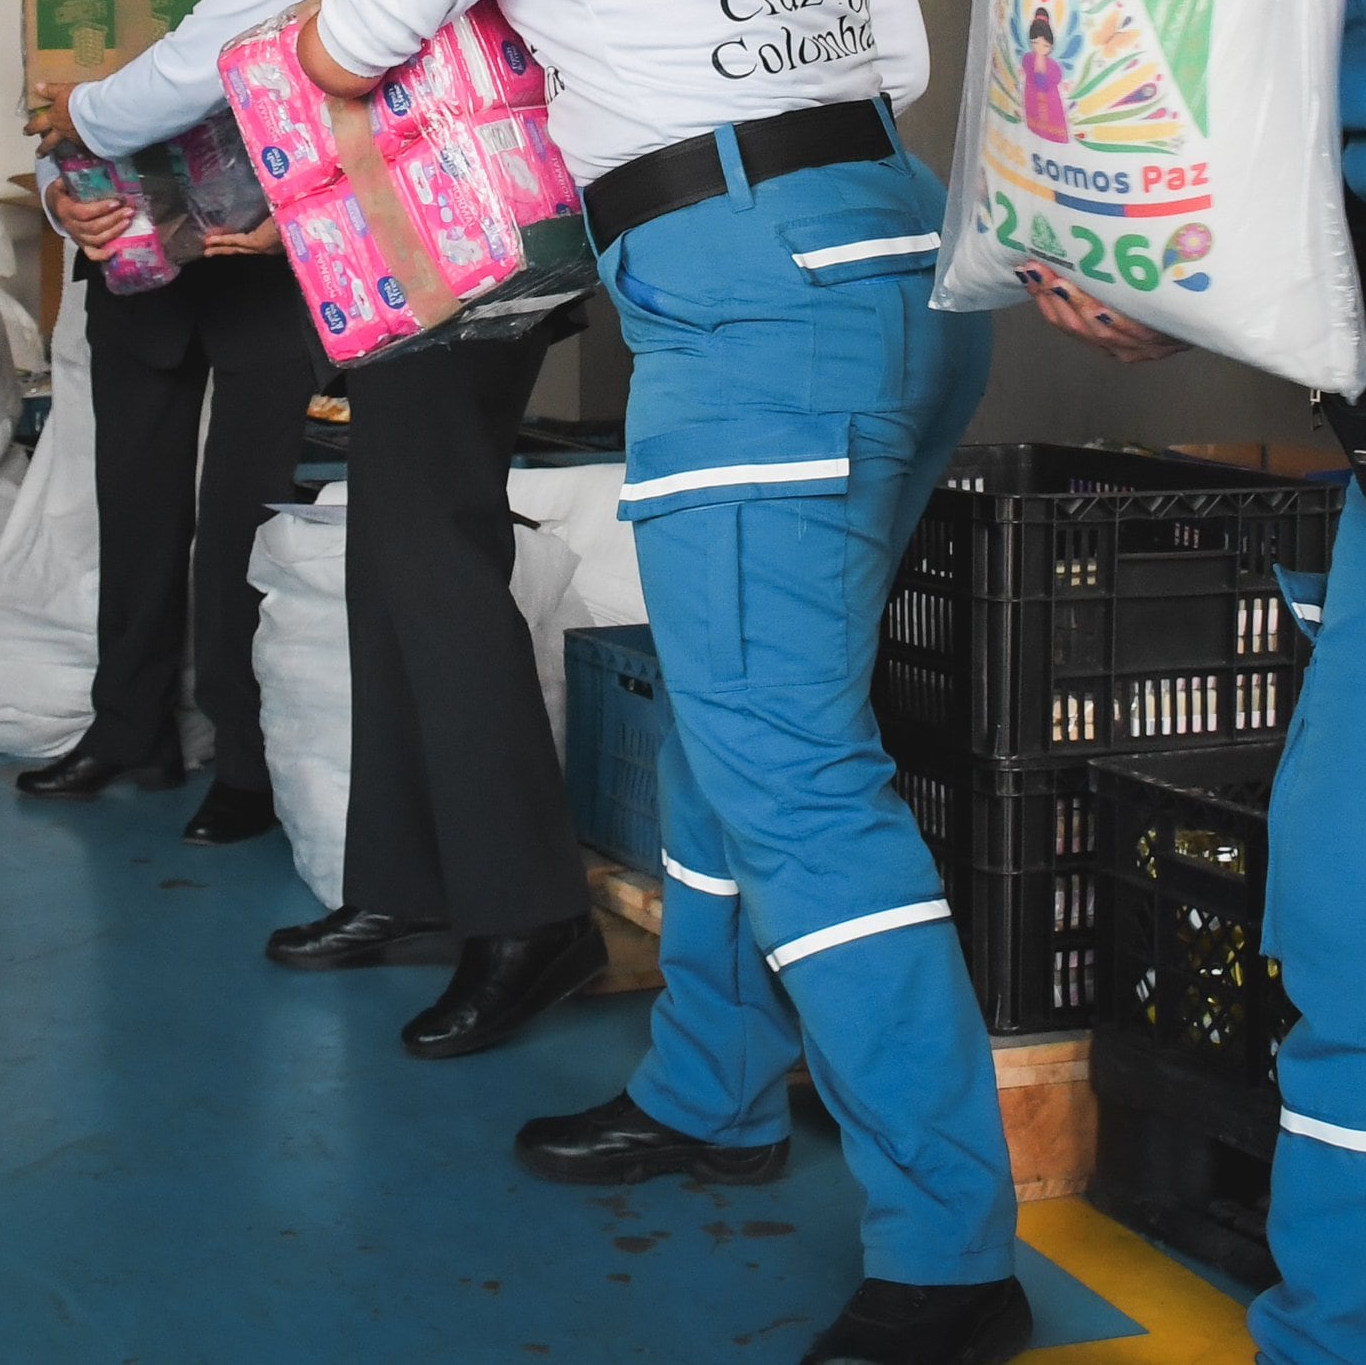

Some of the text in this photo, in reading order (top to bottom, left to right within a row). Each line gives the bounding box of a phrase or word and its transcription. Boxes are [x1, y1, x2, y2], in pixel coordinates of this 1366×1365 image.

[1032, 153, 1209, 195] somos Paz
[315, 251, 337, 298] NORMAL
